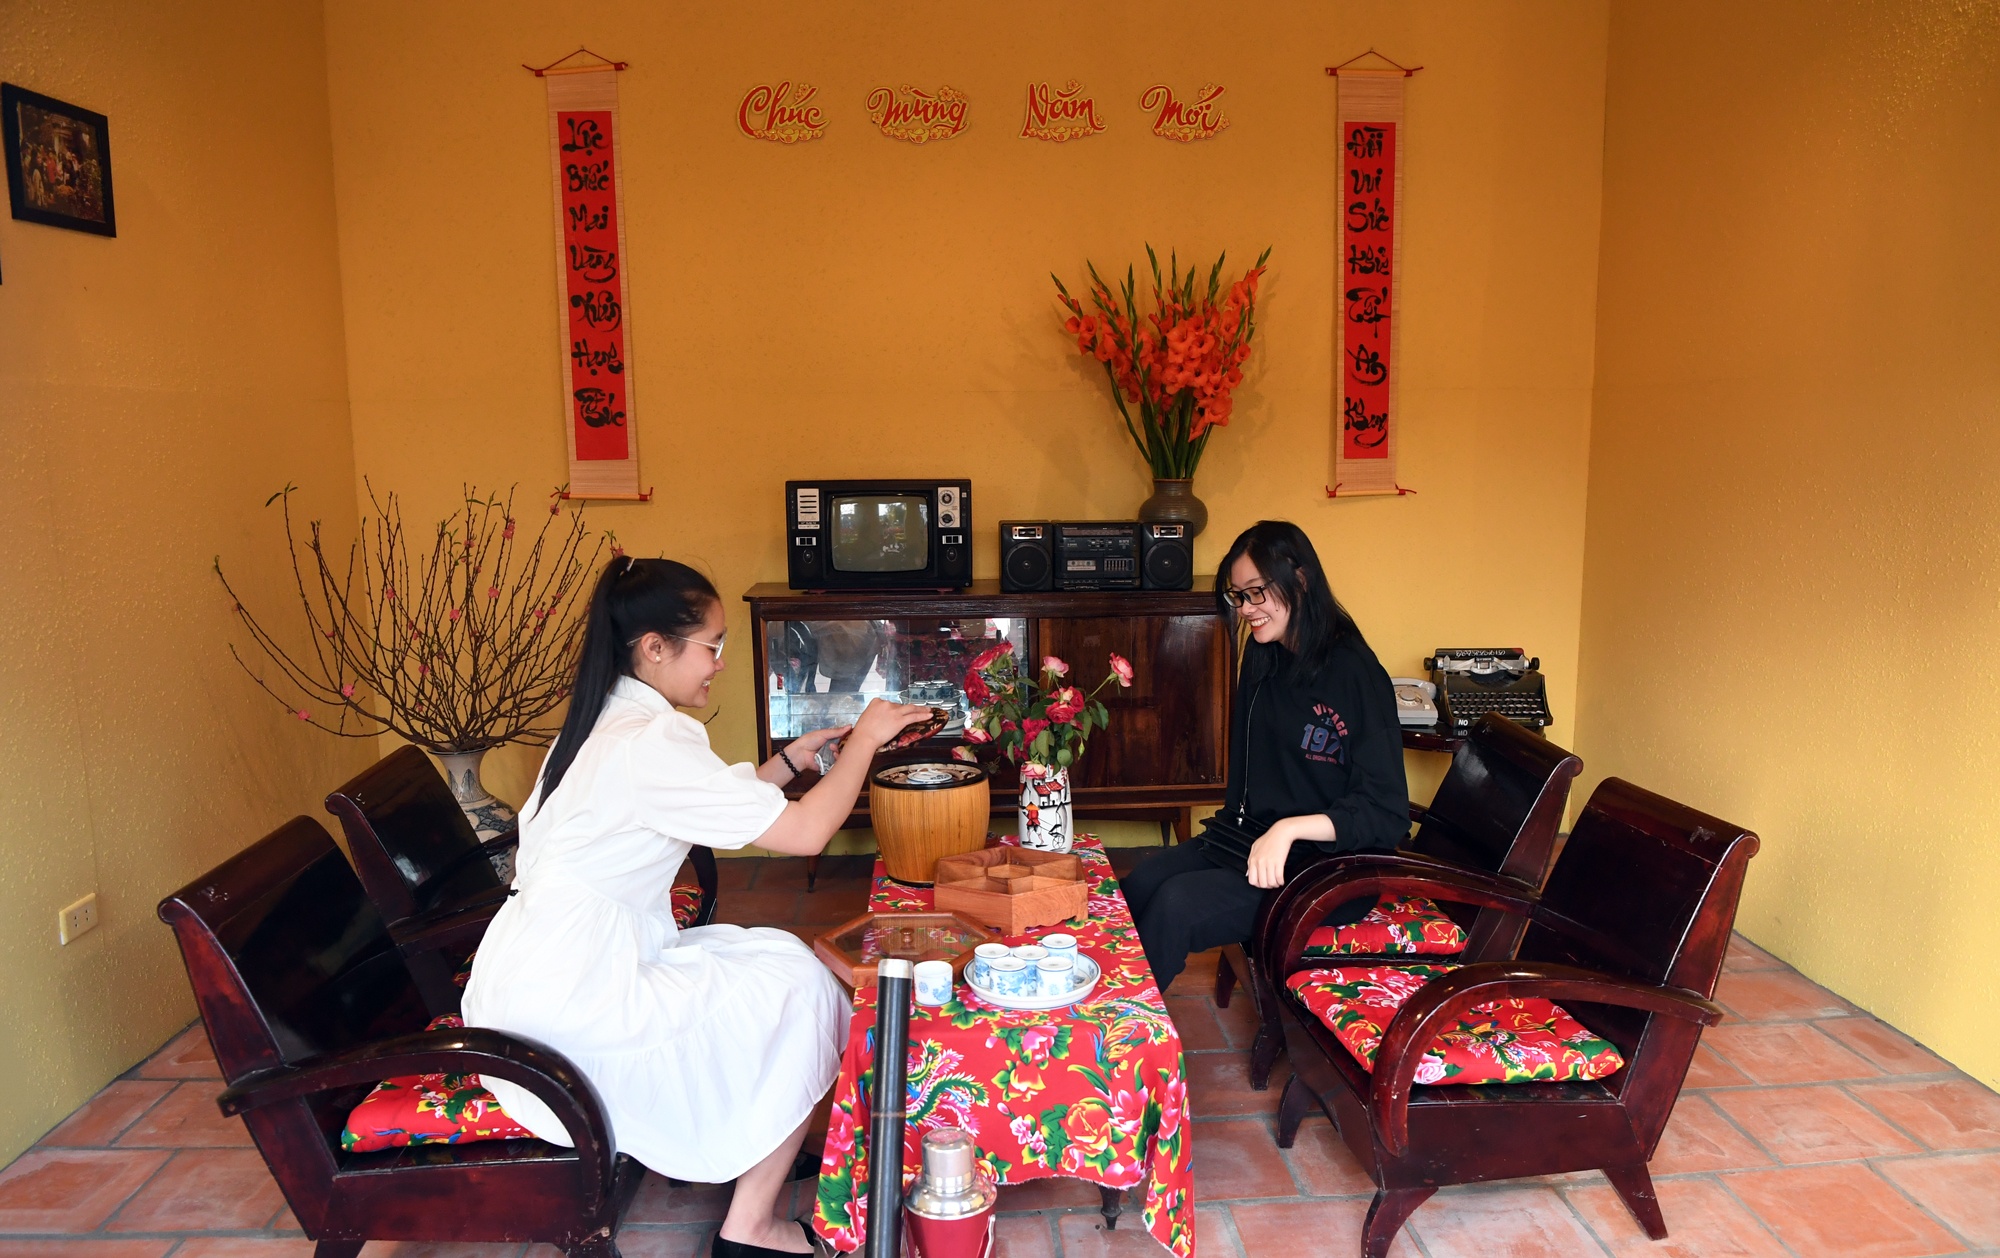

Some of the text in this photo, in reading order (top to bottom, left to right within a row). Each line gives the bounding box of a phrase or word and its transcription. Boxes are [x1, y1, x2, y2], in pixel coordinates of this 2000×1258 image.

[739, 81, 1226, 137] Chúc Mừng Năm Mới
[1351, 168, 1383, 194] Vui
[569, 204, 609, 232] Mai
[1346, 344, 1387, 386] An
